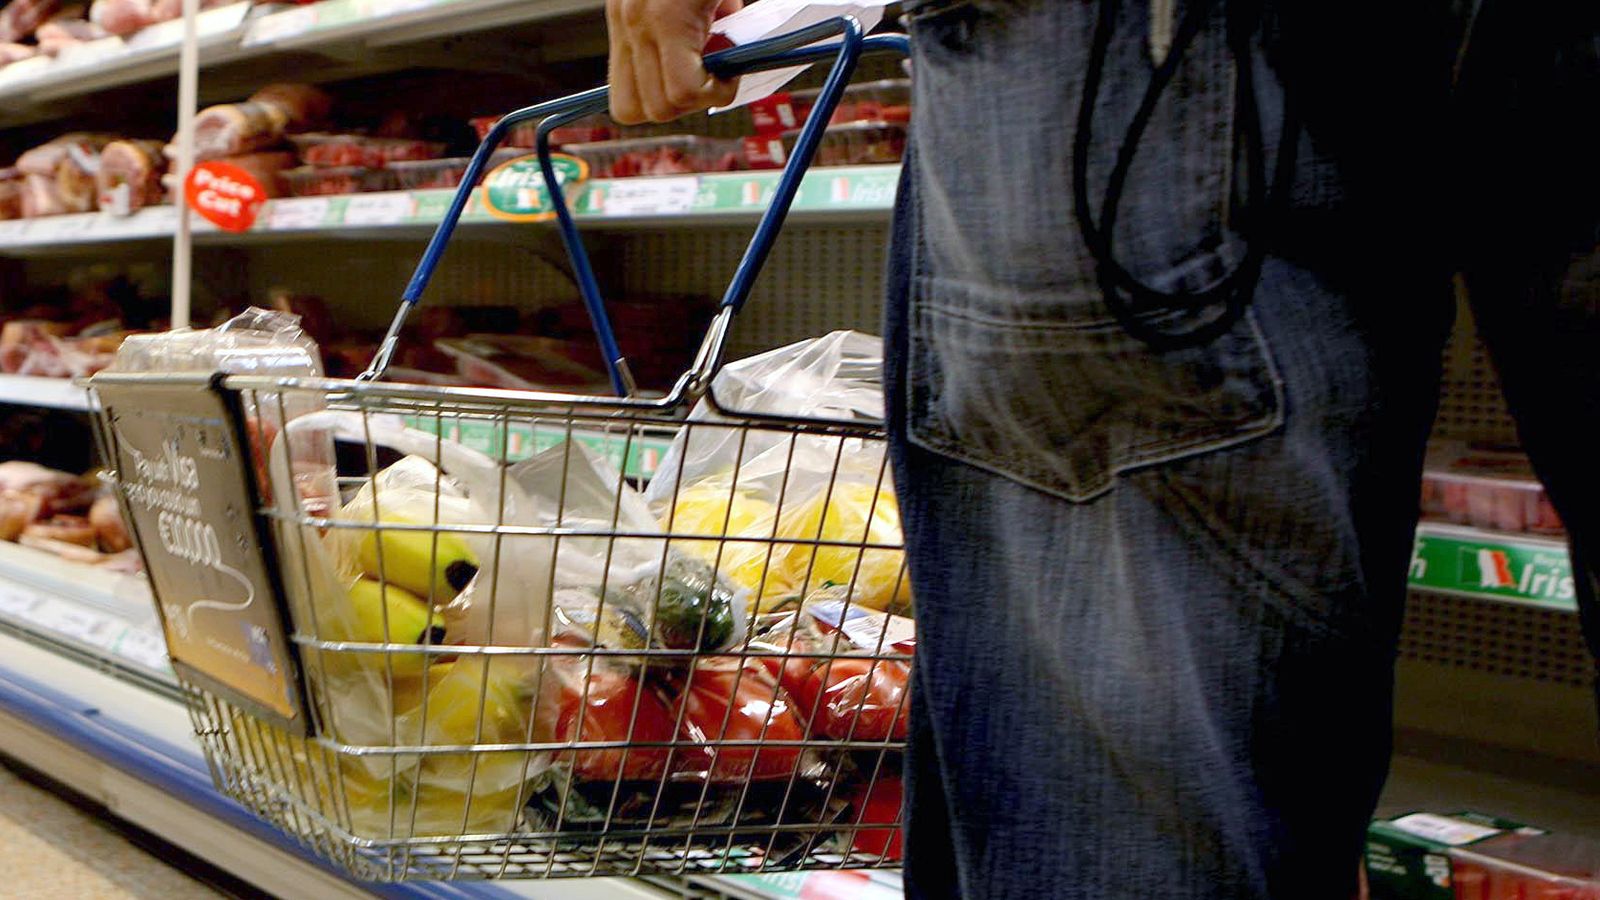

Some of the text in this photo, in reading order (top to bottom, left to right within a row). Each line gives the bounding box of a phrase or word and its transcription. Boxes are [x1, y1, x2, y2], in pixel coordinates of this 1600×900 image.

[193, 168, 255, 200] Price
[198, 189, 242, 217] Cut
[1517, 563, 1576, 599] Iris
